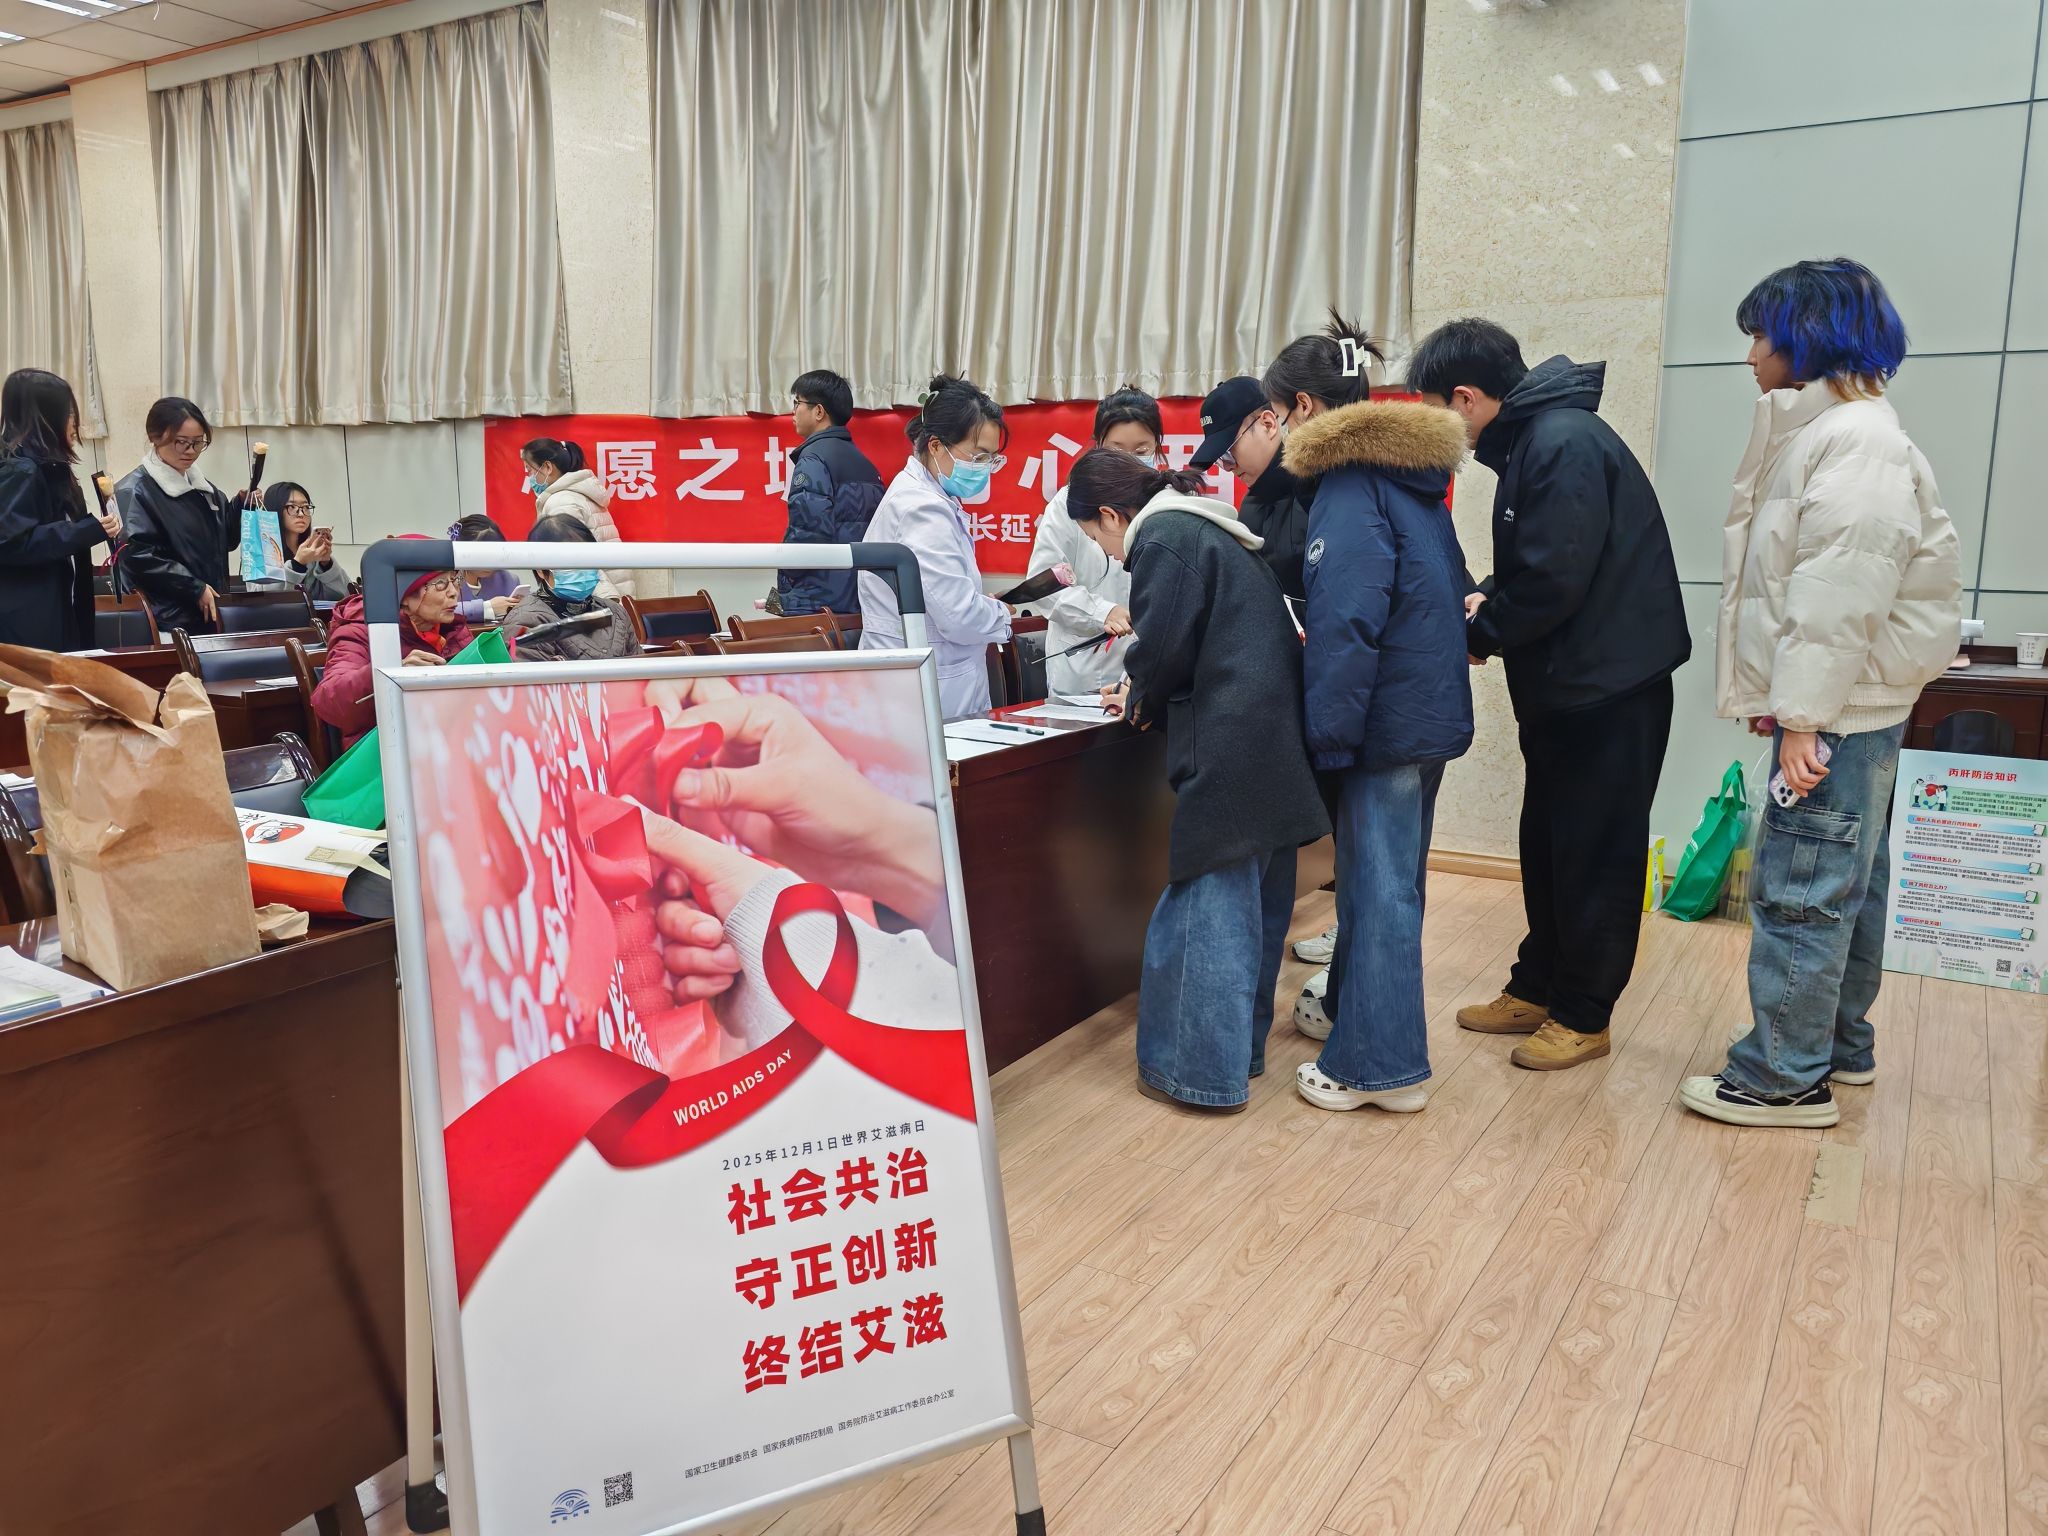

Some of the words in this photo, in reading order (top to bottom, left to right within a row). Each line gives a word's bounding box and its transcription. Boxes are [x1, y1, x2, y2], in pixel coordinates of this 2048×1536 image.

[520, 436, 797, 502] 愿之
[969, 513, 1044, 543] 长延
[1948, 768, 2017, 782] 丙肝防治知识
[673, 1091, 728, 1127] WORLD
[732, 1070, 765, 1099] AIDS
[766, 1049, 793, 1075] DAY
[722, 1119, 926, 1171] 2025年12月1日世界艾滋病日
[727, 1147, 929, 1236] 社会共治
[735, 1217, 938, 1310] 守正创新
[742, 1291, 948, 1394] 终结艾滋
[685, 1448, 758, 1479] 国家卫生健康委员会
[763, 1425, 834, 1454] 国家疾病预防控制局
[838, 1388, 955, 1431] 国务院防治艾滋病工作委员会办公室
